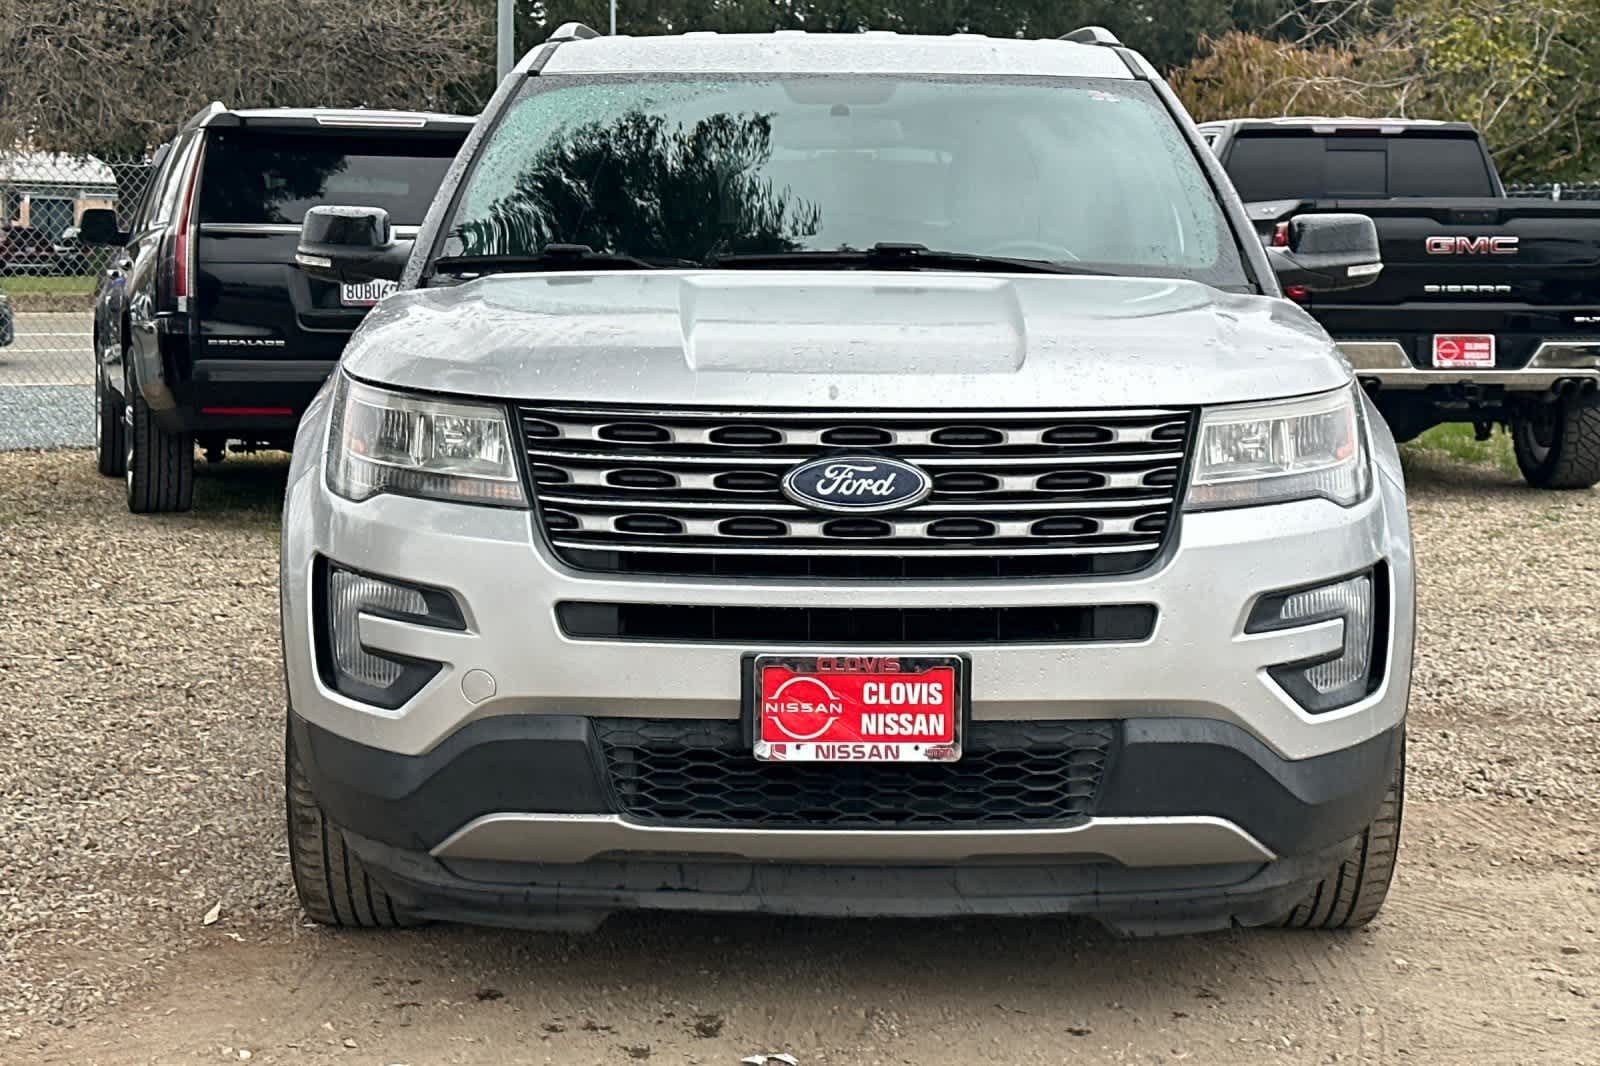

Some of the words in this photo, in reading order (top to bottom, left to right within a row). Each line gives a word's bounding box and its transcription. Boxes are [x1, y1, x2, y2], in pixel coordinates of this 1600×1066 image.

[1425, 236, 1519, 254] GMC
[1424, 285, 1511, 293] SIERRA
[816, 464, 897, 496] Ford
[816, 656, 900, 672] CLOVIS
[863, 682, 943, 705] CLOVIS
[765, 703, 843, 713] NISSAN
[861, 714, 945, 736] NISSAN
[815, 744, 900, 760] NISSAN
